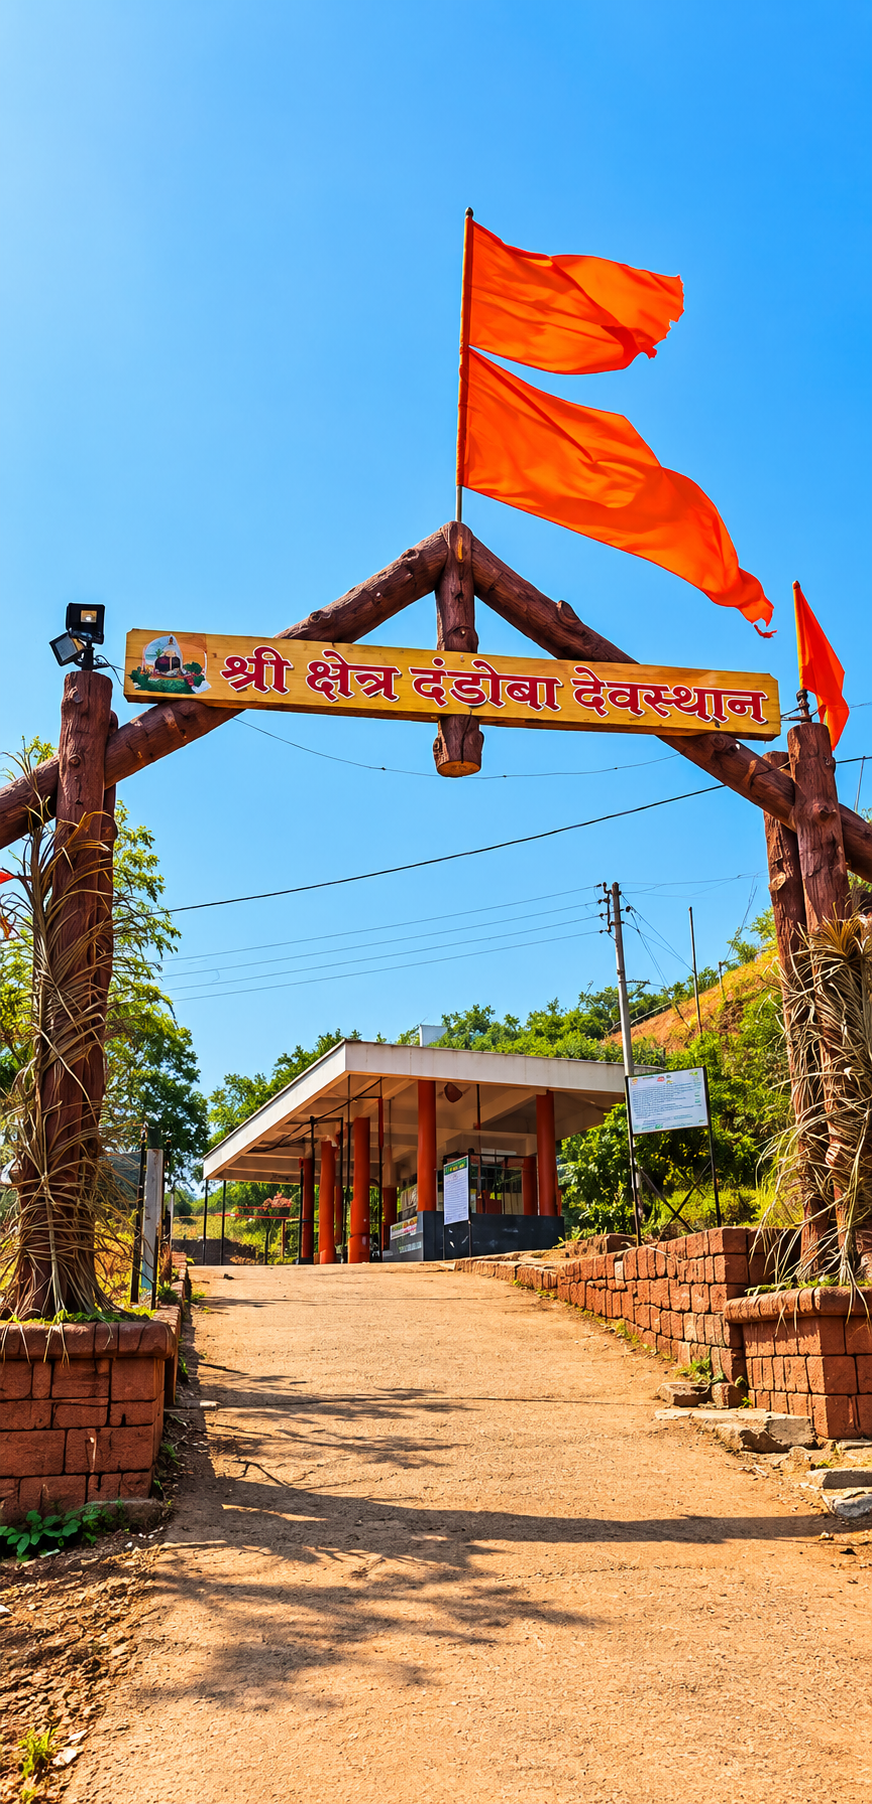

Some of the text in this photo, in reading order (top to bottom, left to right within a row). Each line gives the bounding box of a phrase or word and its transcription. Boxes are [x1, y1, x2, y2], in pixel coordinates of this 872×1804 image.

[220, 645, 768, 724] श्री क्षेत्र दंडोबा देवस्थान
